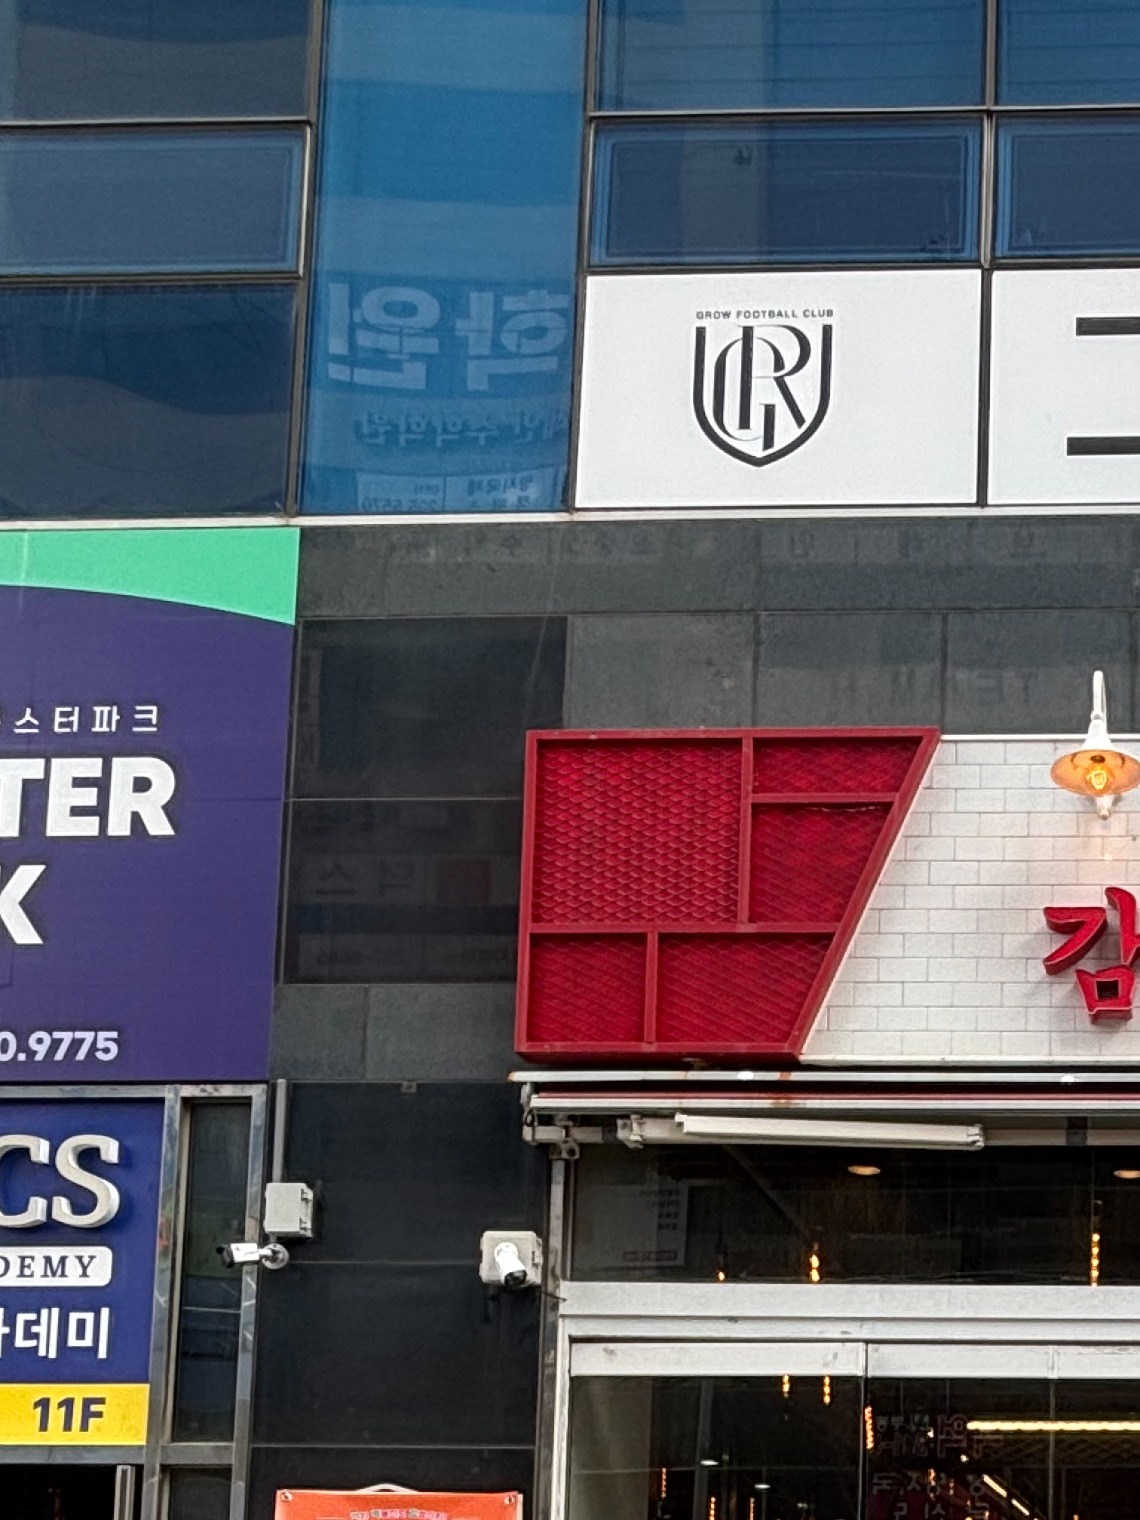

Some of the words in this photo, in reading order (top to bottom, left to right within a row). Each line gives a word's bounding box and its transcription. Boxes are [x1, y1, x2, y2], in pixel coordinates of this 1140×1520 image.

[696, 311, 731, 319] GROW
[736, 310, 797, 319] FOOTBALL
[803, 309, 833, 318] CLUB
[0, 756, 176, 837] TER
[0, 1030, 119, 1062] 0.9775
[0, 1134, 121, 1229] CS
[32, 1396, 107, 1433] 11F
